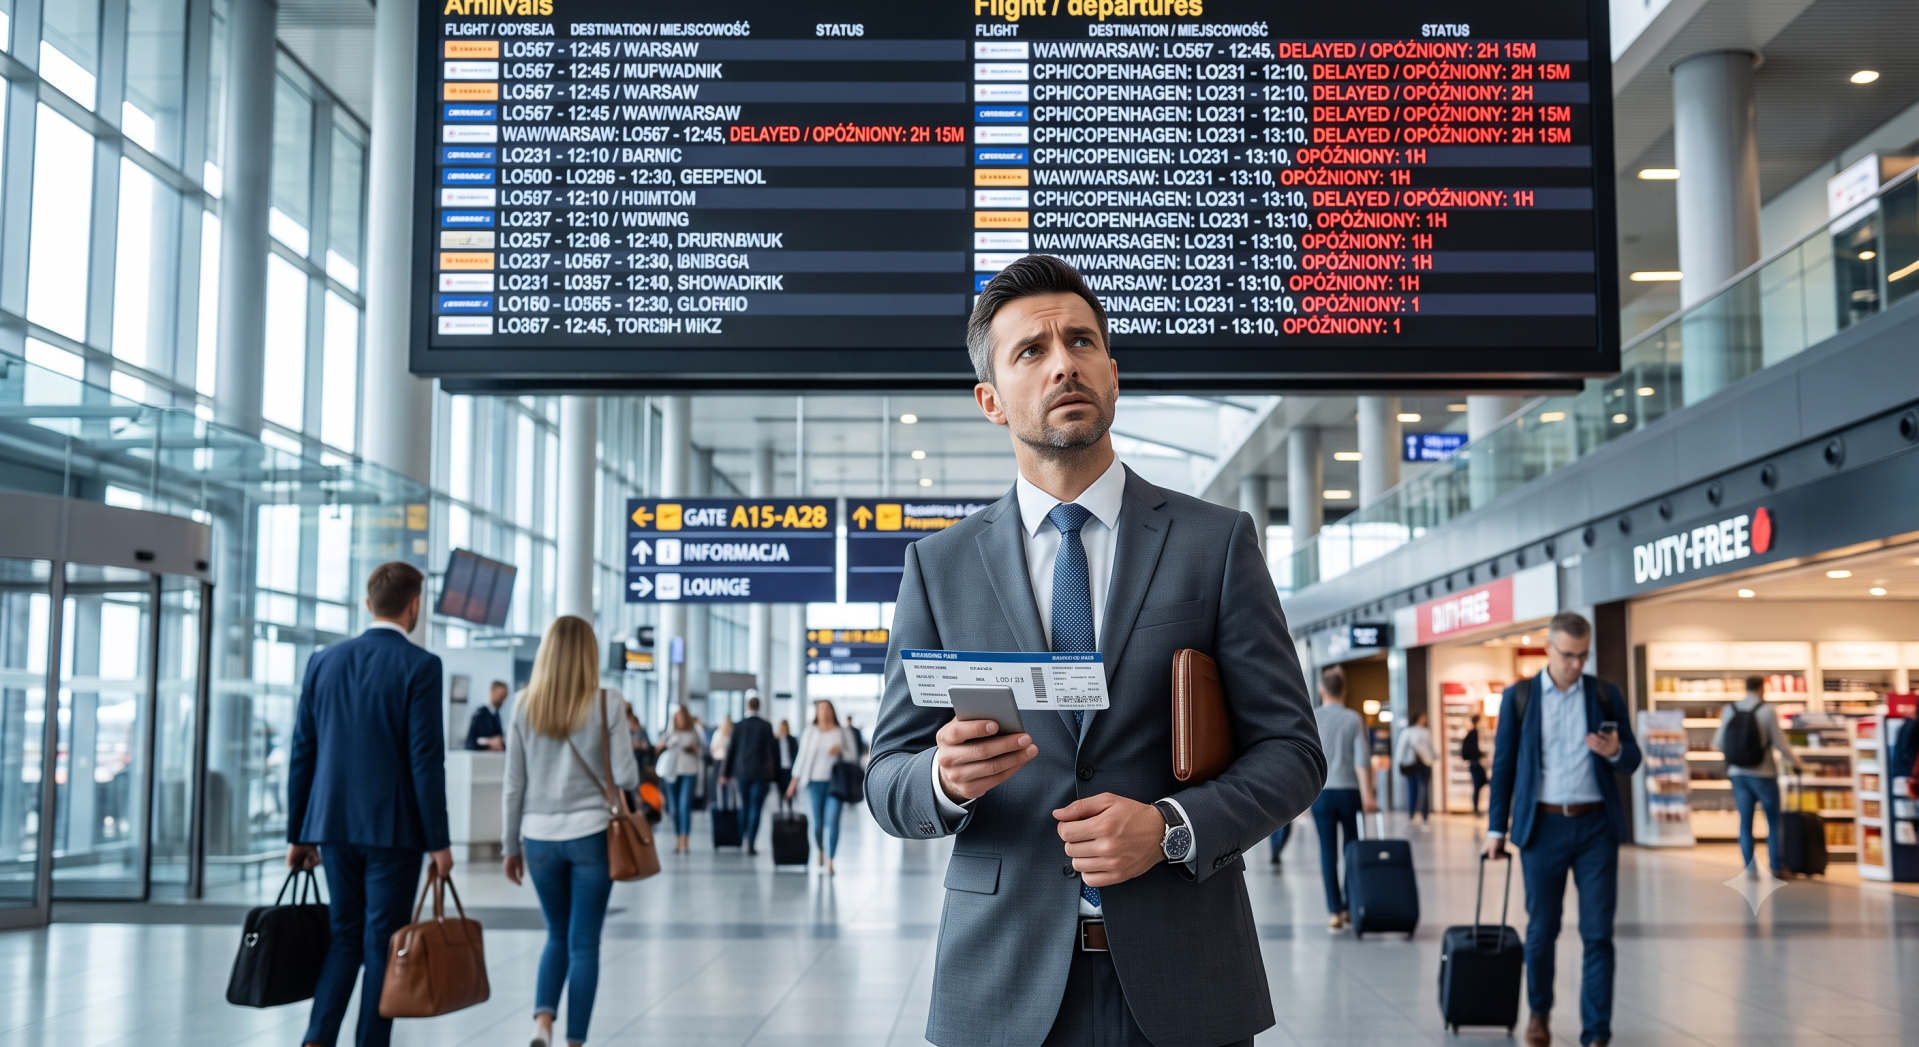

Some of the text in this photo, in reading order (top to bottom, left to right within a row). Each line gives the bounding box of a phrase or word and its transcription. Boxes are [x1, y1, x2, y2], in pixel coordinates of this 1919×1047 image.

[1067, 0, 1203, 21] departures
[445, 23, 555, 36] FLIGHT ODYSEJA
[571, 21, 751, 36] DESTINATION MIEJSCOWOŚĆ
[816, 24, 864, 36] STATUS
[975, 24, 1019, 37] FLIGHT
[1089, 21, 1268, 37] DESTINATION MIEJSCOWOŚĆ
[1422, 24, 1470, 37] STATUS
[504, 41, 554, 57] LO567
[569, 41, 610, 57] 12:45
[624, 41, 699, 57] WARSAW
[1033, 40, 1536, 60] WAW/WARSAW: LO567 12:45, DELAYED OPÓŹNIONY: 2H 15M
[504, 63, 554, 78] LO567
[569, 63, 610, 78] 12:45
[1033, 61, 1570, 82] CPH/COPENHAGEN: LO231 12:10, DELAYED OPÓŹNIONY: 2H 15M
[503, 84, 554, 100] LO567
[569, 84, 610, 100] 12:45
[623, 84, 699, 100] WARSAW
[1033, 82, 1533, 103] CPH/COPENHAGEN: LO231 12:10, DELAYED OPÓŹNIONY: 2H
[503, 105, 554, 121] LO567
[568, 105, 610, 121] 12:45
[623, 105, 741, 121] WAW/WARSAW
[1033, 106, 1191, 122] CPH/COPENHAGEN:
[1197, 106, 1244, 122] LO231
[1263, 106, 1307, 124] 12:10,
[1313, 106, 1390, 122] DELAYED
[1403, 103, 1507, 122] OPÓŹNIONY:
[1512, 106, 1533, 122] 2H
[1538, 106, 1570, 122] 15M
[502, 123, 964, 144] WAW/WARSAW: LO567 12:45, DELAYED OPÓŹNIONY: 2H 15M
[1033, 124, 1571, 145] CPH/COPENHAGEN: LO231 13:10, DELAYED OPÓŹNIONY: 2H 15M
[502, 147, 551, 163] LO231
[567, 147, 609, 163] 12:10
[1033, 148, 1175, 164] CPH/COPENIGEN:
[1180, 148, 1228, 164] LO231
[1245, 148, 1291, 166] 13:10,
[1296, 145, 1400, 164] OPÓŹNIONY:
[1405, 148, 1426, 164] 1H
[502, 169, 552, 184] LO500
[567, 169, 615, 184] LO296
[631, 169, 675, 186] 12:30,
[680, 169, 766, 184] GEEPENOL
[1033, 170, 1159, 185] WAW/WARSAW:
[1164, 170, 1212, 185] LO231
[1230, 170, 1275, 187] 13:10,
[1280, 167, 1384, 185] OPÓŹNIONY:
[1390, 170, 1410, 185] 1H
[567, 190, 609, 206] 12:10
[1033, 188, 1533, 209] CPH/COPENHAGEN: LO231 13:10, DELAYED OPÓŹNIONY: 1H
[501, 211, 552, 227] LO237
[567, 211, 609, 227] 12:10
[1033, 212, 1195, 228] CPH/COPENHAGEN:
[1200, 212, 1248, 228] LO231
[1266, 212, 1312, 230] 13:10,
[1317, 209, 1420, 228] OPÓŹNIONY:
[1426, 212, 1447, 228] 1H
[500, 232, 551, 248] LO257
[1033, 230, 1432, 251] WAW/WARSAGEN: LO231 13:10, OPÓŹNIONY: 1H
[500, 253, 551, 269] LO237
[565, 253, 611, 269] LO567
[627, 253, 673, 271] 12:30,
[1185, 254, 1233, 270] LO231
[1302, 251, 1405, 270] OPÓŹNIONY:
[1412, 254, 1432, 270] 1H
[499, 274, 548, 290] LO231
[1172, 275, 1220, 291] LO231
[1238, 275, 1284, 293] 13:10,
[1289, 272, 1393, 291] OPÓŹNIONY:
[1399, 275, 1419, 291] 1H
[627, 296, 673, 314] 12:30,
[1185, 296, 1233, 312] LO231
[1251, 296, 1297, 314] 13:10,
[1412, 296, 1419, 312] 1
[565, 317, 611, 335] 12:45,
[1166, 318, 1214, 334] LO231
[1232, 318, 1278, 336] 13:10,
[1393, 318, 1400, 334] 1
[683, 505, 828, 529] GATE A15-A28
[683, 543, 790, 562] INFORMACJA
[1633, 514, 1751, 584] DUTY-FREE
[683, 578, 751, 597] LOUNGE
